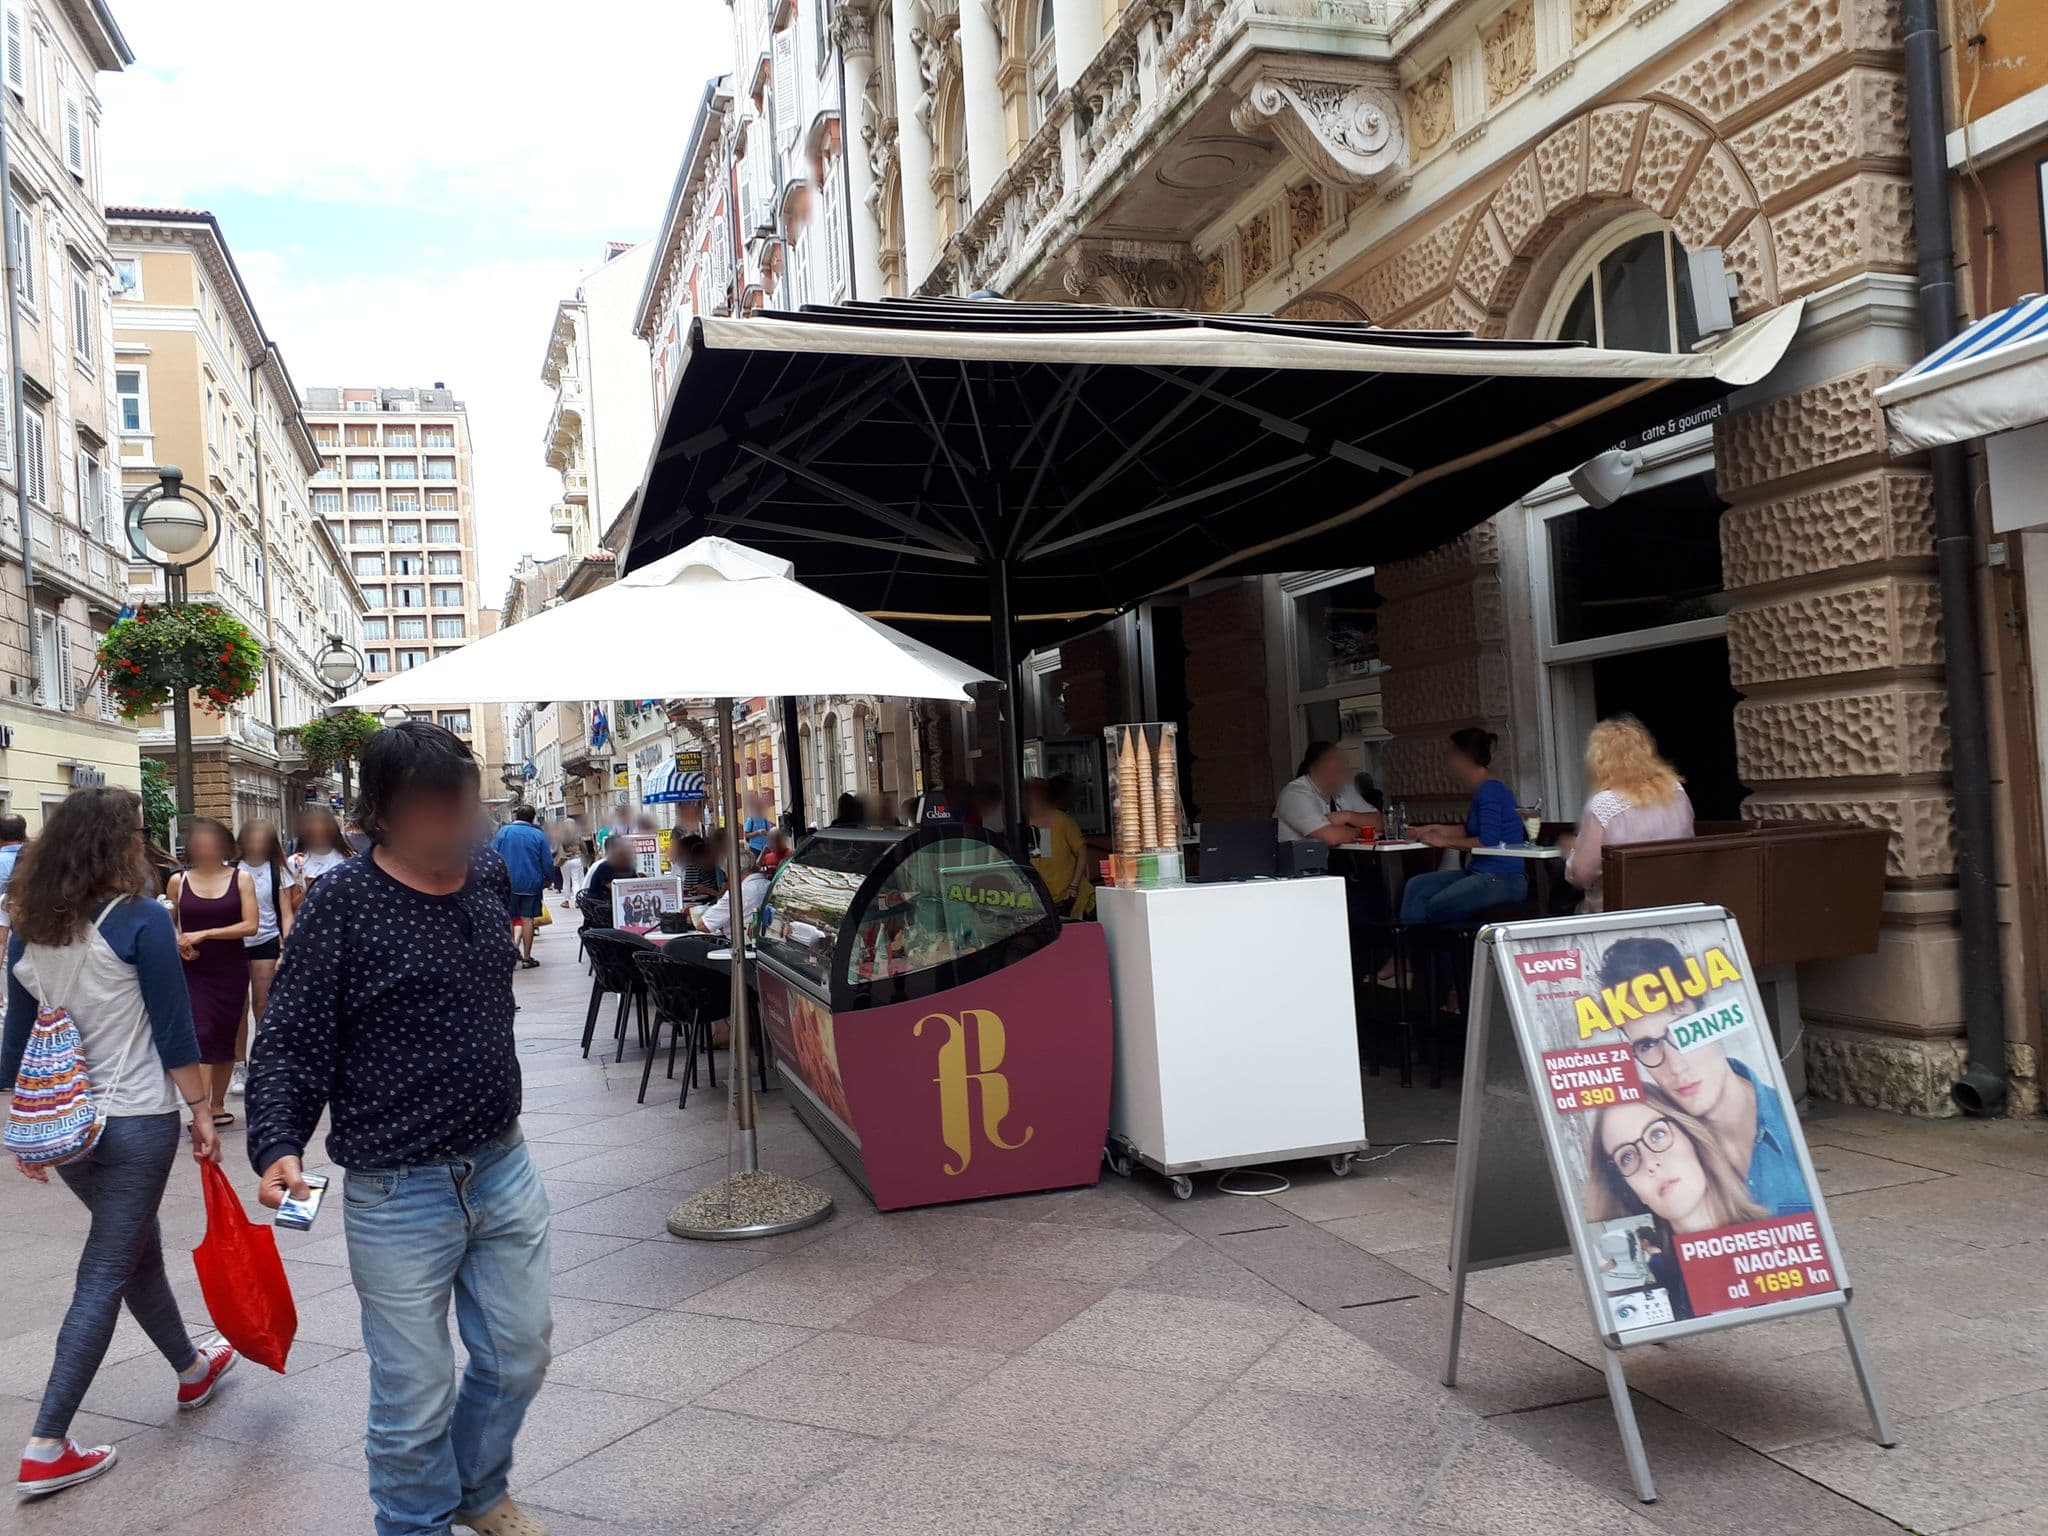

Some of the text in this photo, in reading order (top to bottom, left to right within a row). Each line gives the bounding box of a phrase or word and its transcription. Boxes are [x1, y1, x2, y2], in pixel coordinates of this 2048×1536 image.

[1668, 419, 1676, 433] &
[1678, 403, 1722, 432] gourmet
[926, 810, 951, 819] Gelato
[1574, 947, 1742, 1040] AKCIJA
[1673, 1003, 1744, 1048] DANAS
[1545, 1050, 1630, 1071] NAOČALE ZA
[1550, 1066, 1625, 1090] ČITANJE
[1556, 1086, 1640, 1109] od 390 kn
[1680, 1222, 1817, 1261] PROGRESIVNE
[1733, 1243, 1824, 1275] NAOČALE
[1727, 1266, 1830, 1299] od 1699 kn
